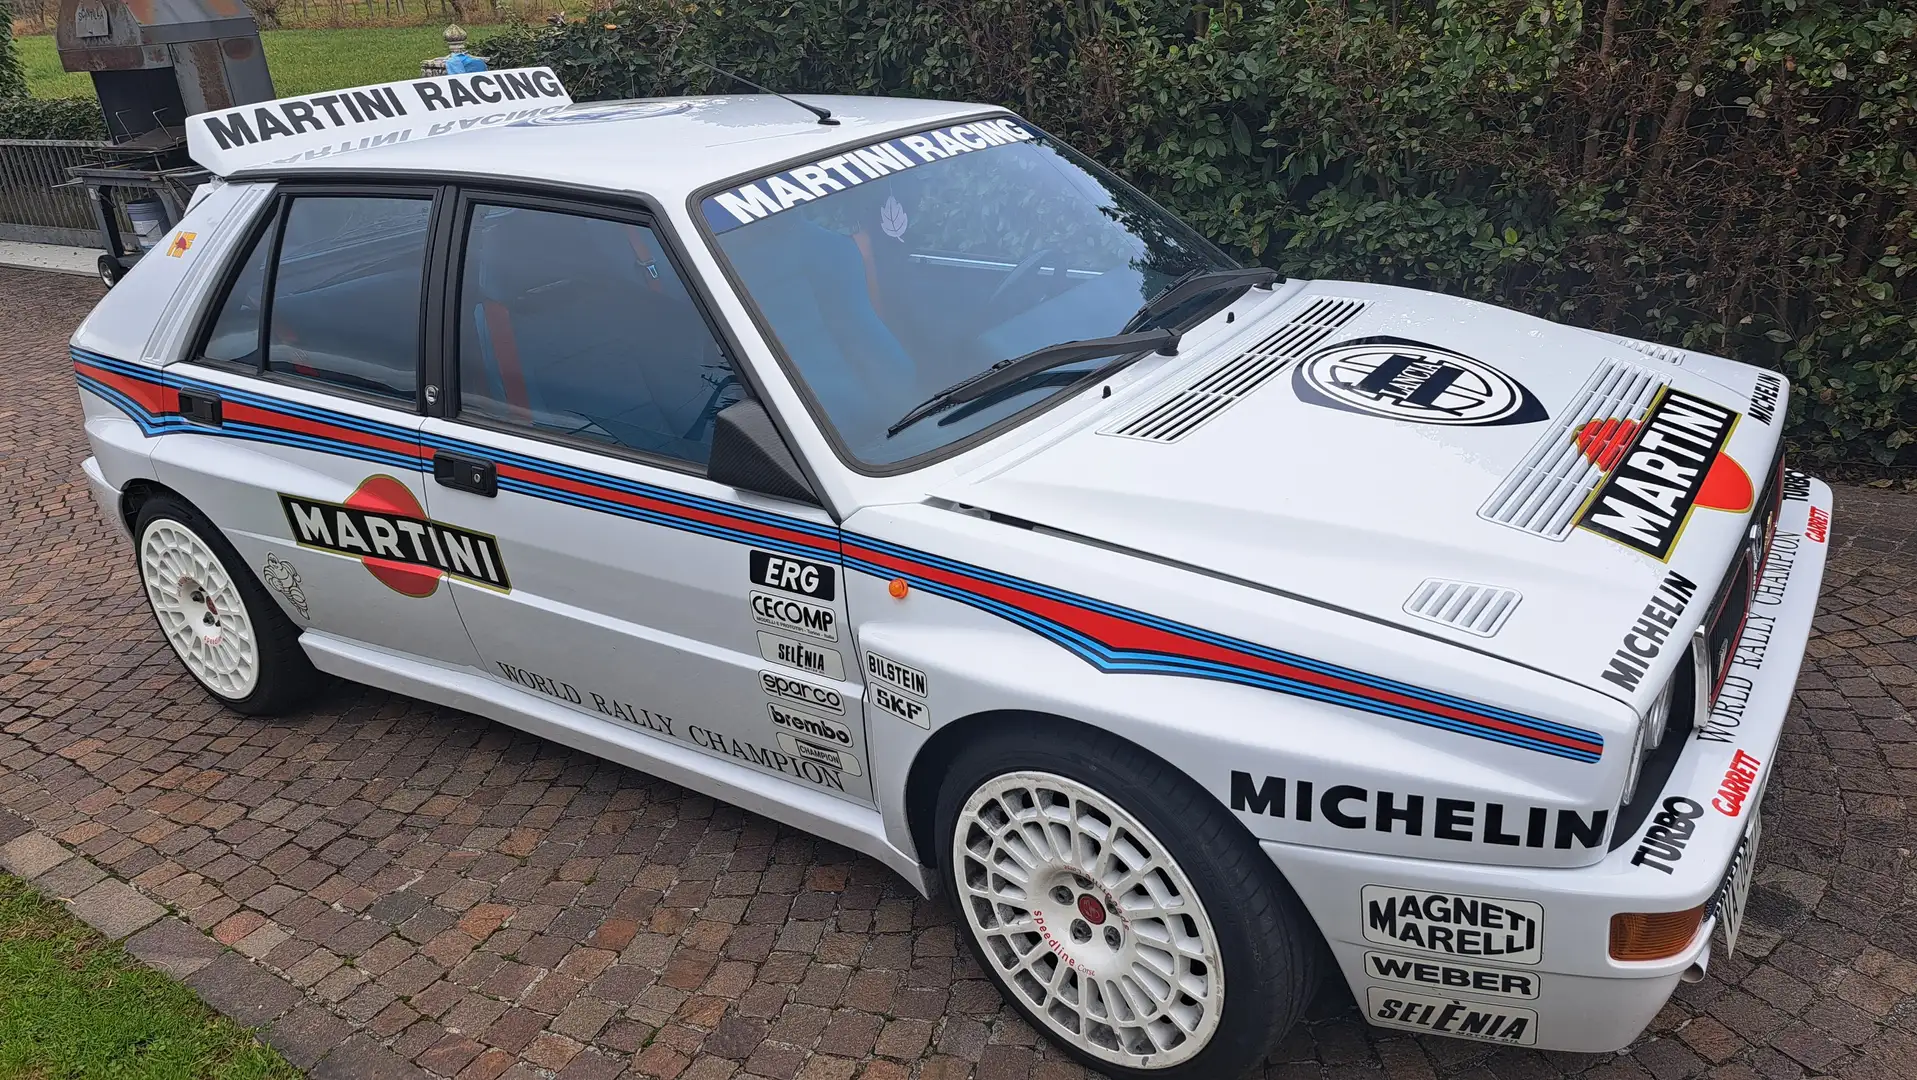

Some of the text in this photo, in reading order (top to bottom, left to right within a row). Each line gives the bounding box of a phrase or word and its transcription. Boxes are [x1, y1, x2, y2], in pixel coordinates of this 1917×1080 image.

[203, 70, 565, 150] MARTINI RACING
[714, 118, 1034, 225] MARTINI RACING
[1379, 361, 1443, 400] LANCIA
[1747, 373, 1781, 426] MICHELIN
[1590, 394, 1729, 548] MARTINI
[290, 501, 500, 583] MARTINI
[764, 557, 820, 593] ERG
[752, 595, 833, 632] CECOMP
[1600, 569, 1698, 693] MICHELIN
[778, 642, 825, 672] SELÈNIA
[1696, 530, 1802, 744] WORLD RALLY CHAMPION
[763, 673, 840, 707] sparco
[868, 654, 925, 694] BILSTEIN
[495, 660, 845, 793] WORLD RALLY CHAMPION
[770, 705, 850, 744] brembo
[877, 688, 922, 720] SKF
[800, 745, 840, 764] CHAMPION
[1711, 748, 1761, 818] GARRETT
[1230, 769, 1609, 850] MICHELIN
[1630, 796, 1704, 876] TURBO
[1369, 895, 1536, 940] MAGNETI
[1369, 910, 1536, 956] MARELLI
[1034, 910, 1096, 977] speedline Corse
[1371, 956, 1532, 996] WEBER
[1376, 998, 1530, 1040] SELÈNIA
